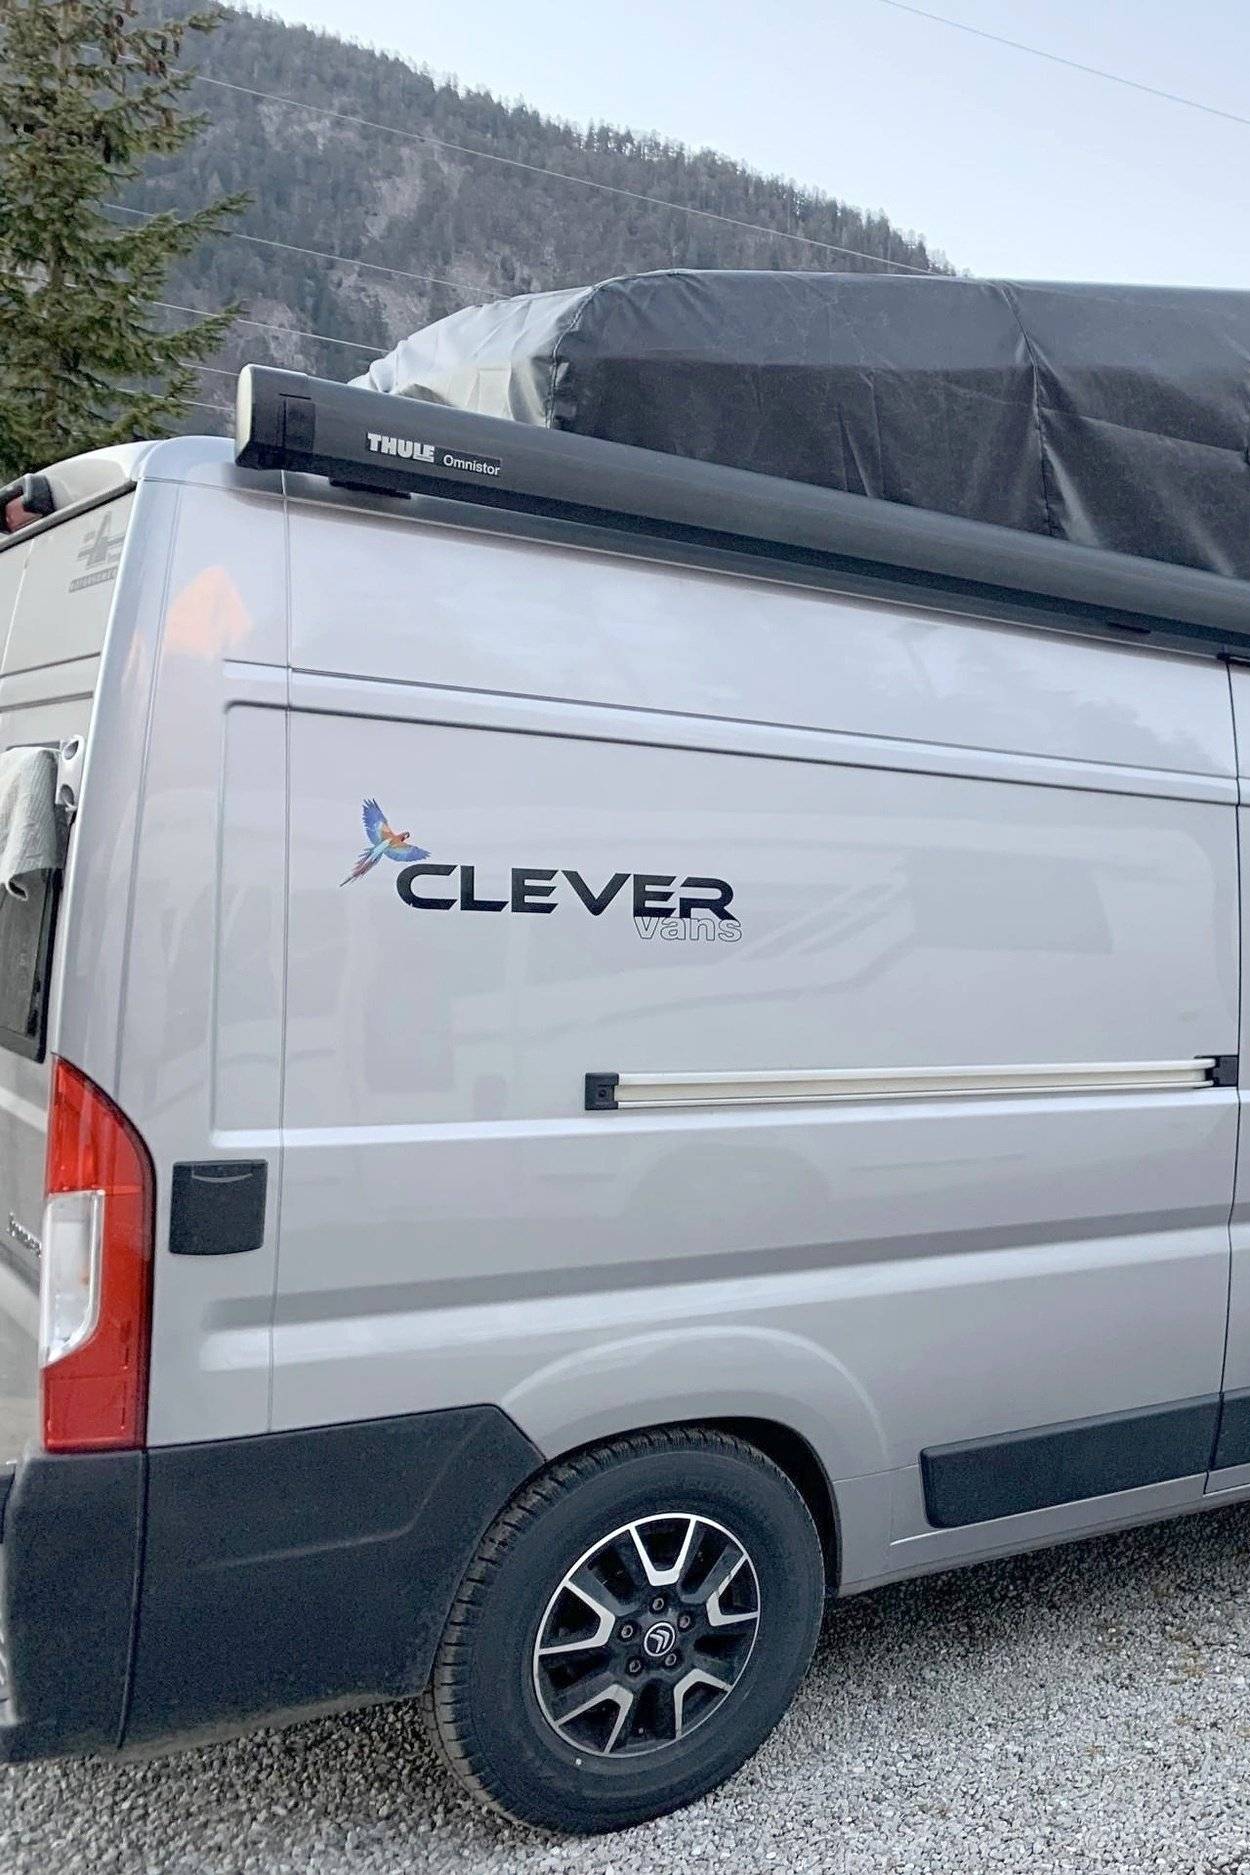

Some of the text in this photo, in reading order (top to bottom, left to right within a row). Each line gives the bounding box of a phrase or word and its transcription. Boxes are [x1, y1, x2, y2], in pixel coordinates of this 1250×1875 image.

[367, 432, 500, 476] THULE Omnistor
[396, 863, 739, 921] CLEVER
[633, 916, 743, 943] vans
